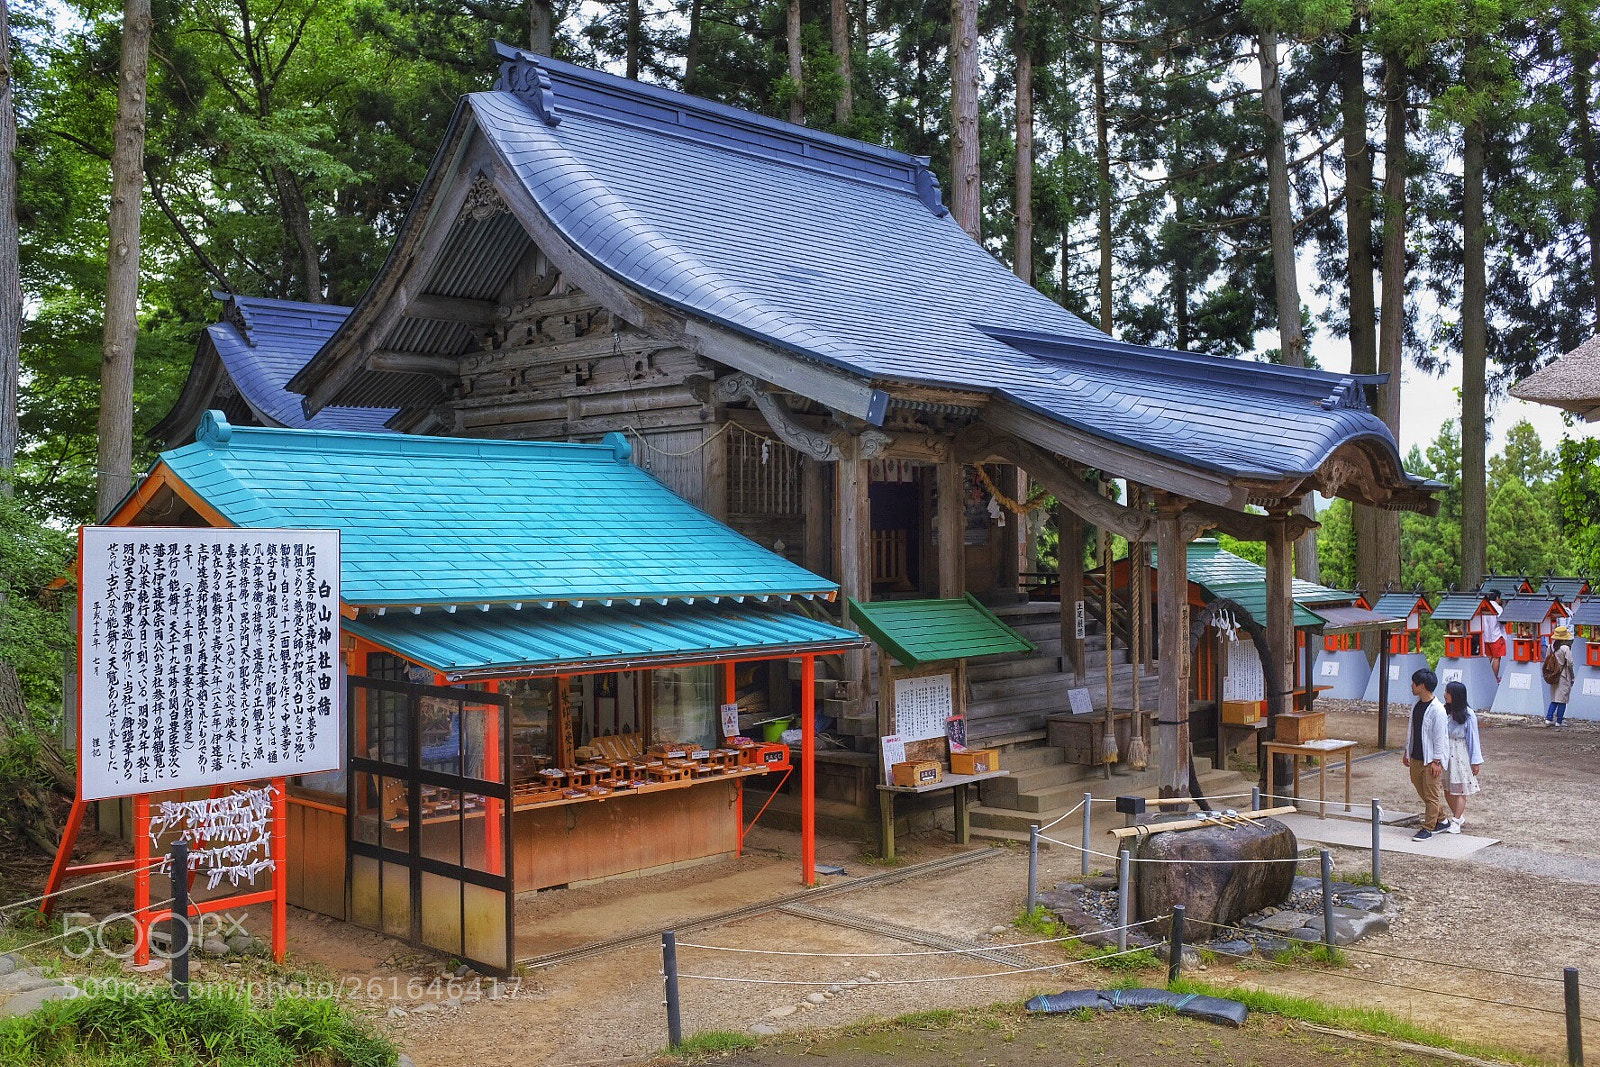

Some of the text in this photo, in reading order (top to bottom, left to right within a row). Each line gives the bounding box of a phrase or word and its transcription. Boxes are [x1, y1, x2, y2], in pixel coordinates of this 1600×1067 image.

[317, 579, 332, 717] 白山神社由緒
